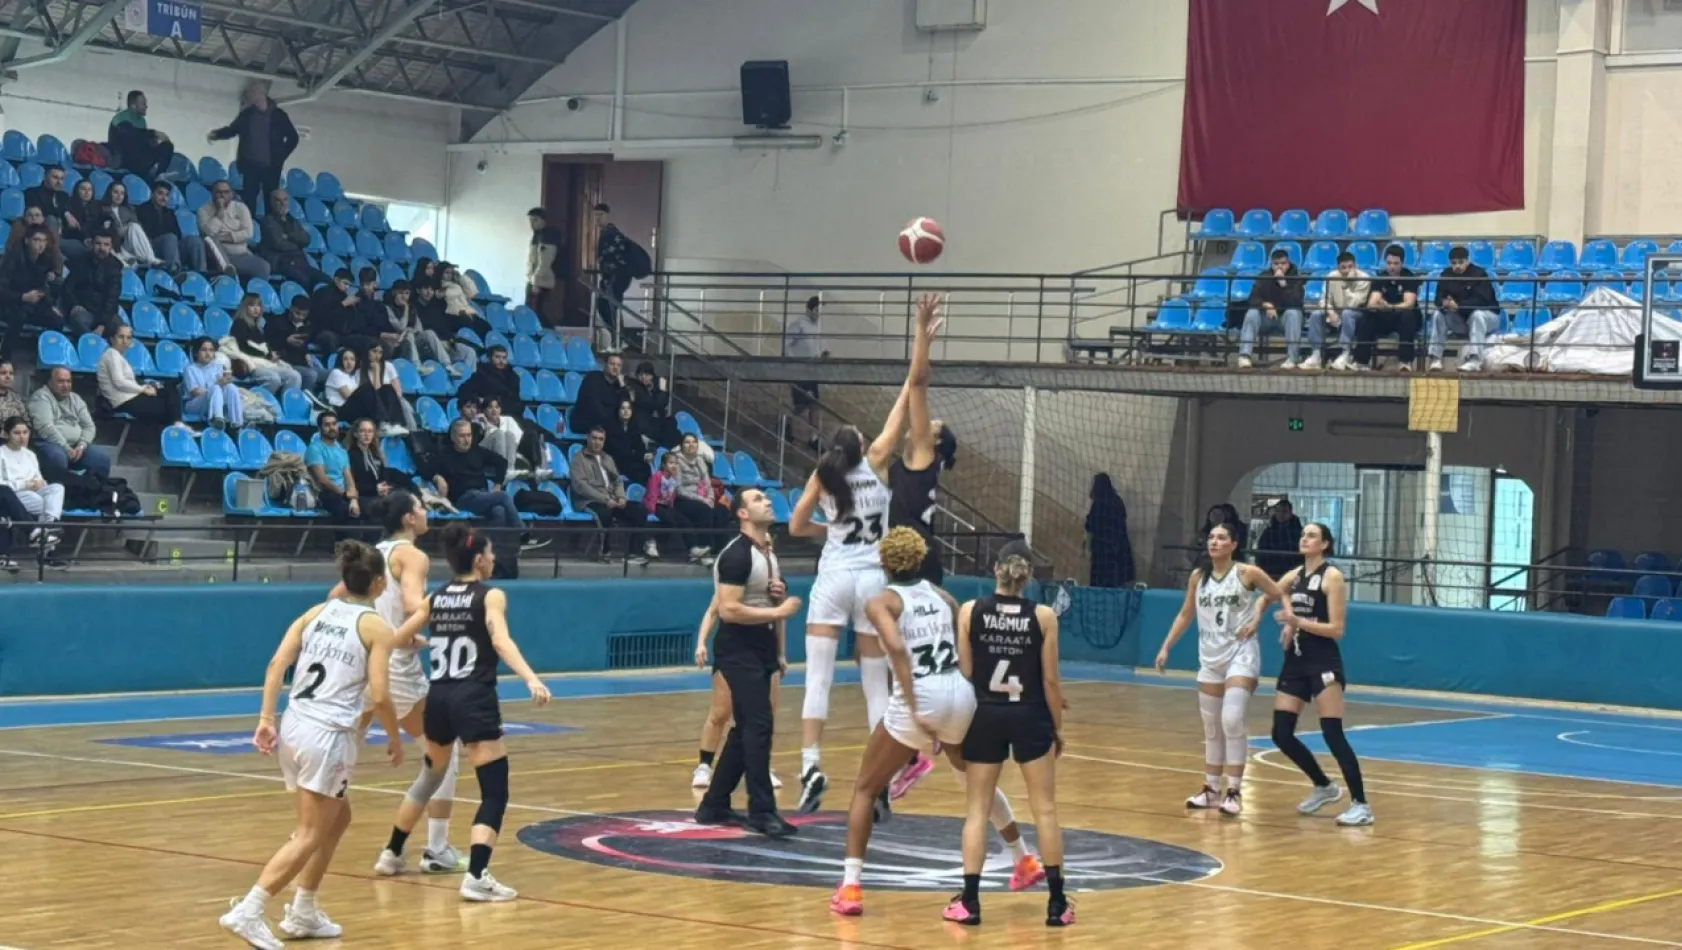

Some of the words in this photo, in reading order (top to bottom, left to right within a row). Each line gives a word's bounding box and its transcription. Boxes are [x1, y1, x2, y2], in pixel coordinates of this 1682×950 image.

[170, 21, 182, 38] A
[843, 511, 883, 544] 23
[1216, 610, 1225, 627] 6
[979, 632, 1032, 645] KARAATA
[988, 645, 1024, 656] BETON
[430, 636, 478, 680] 30
[911, 641, 960, 678] 32
[294, 661, 327, 700] 2
[989, 659, 1024, 702] 4
